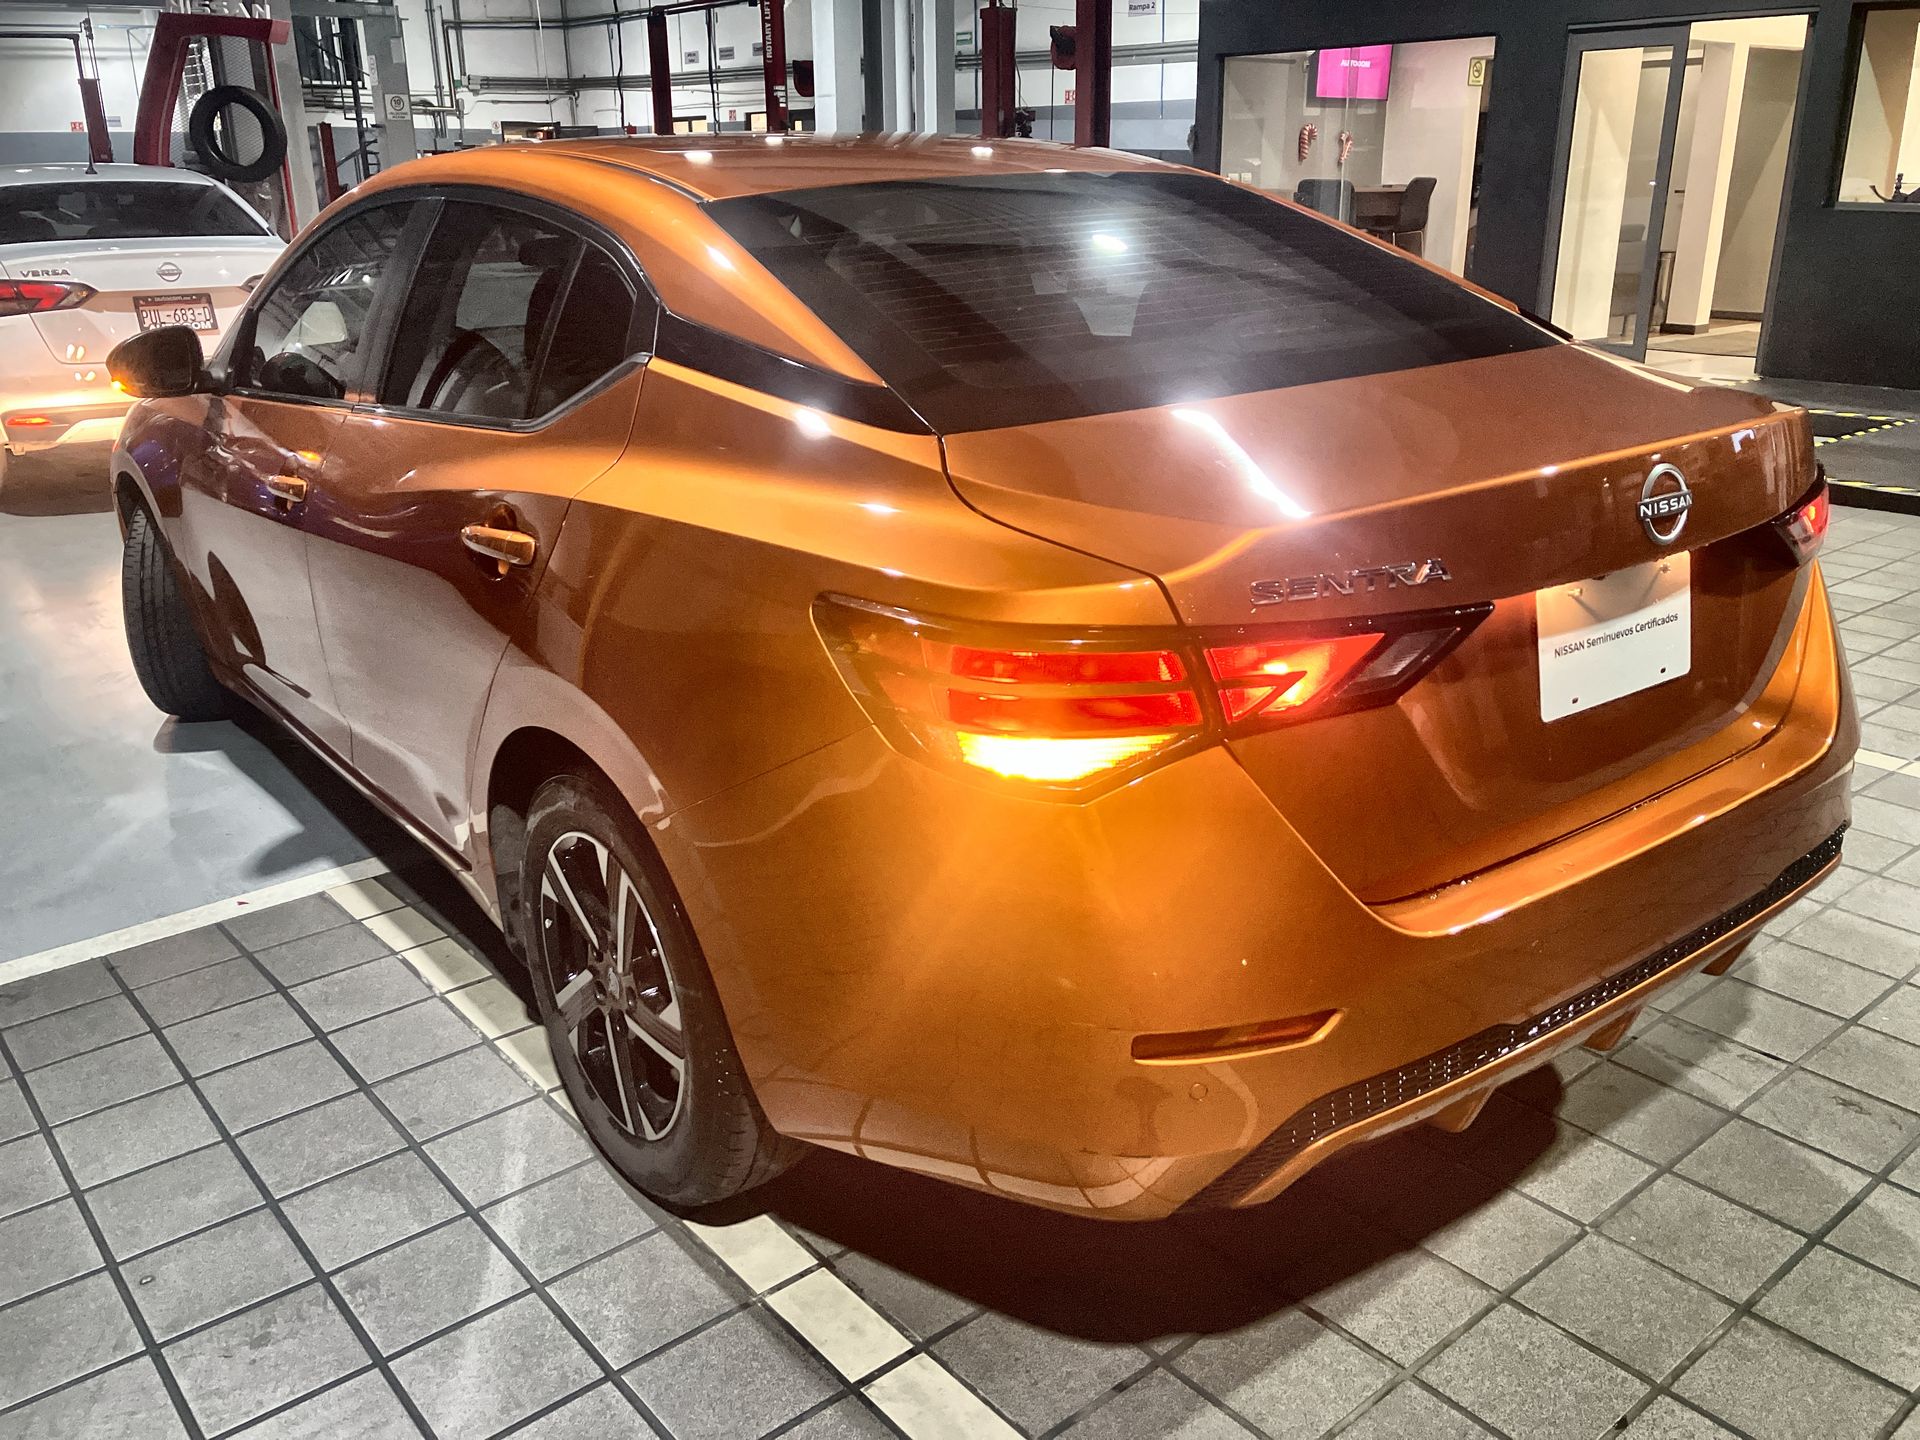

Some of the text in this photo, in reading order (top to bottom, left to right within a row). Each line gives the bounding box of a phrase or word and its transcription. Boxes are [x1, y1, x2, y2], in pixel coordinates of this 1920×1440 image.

[763, 0, 773, 58] ROTARY LIFT
[1340, 59, 1371, 68] AUTOCOM
[20, 269, 71, 278] VERSA
[141, 306, 211, 325] PUL-683-D
[1640, 494, 1692, 517] NISSAN
[1250, 558, 1452, 605] SENTRA
[1554, 613, 1679, 659] NISSAN Seminuevos Certificados
